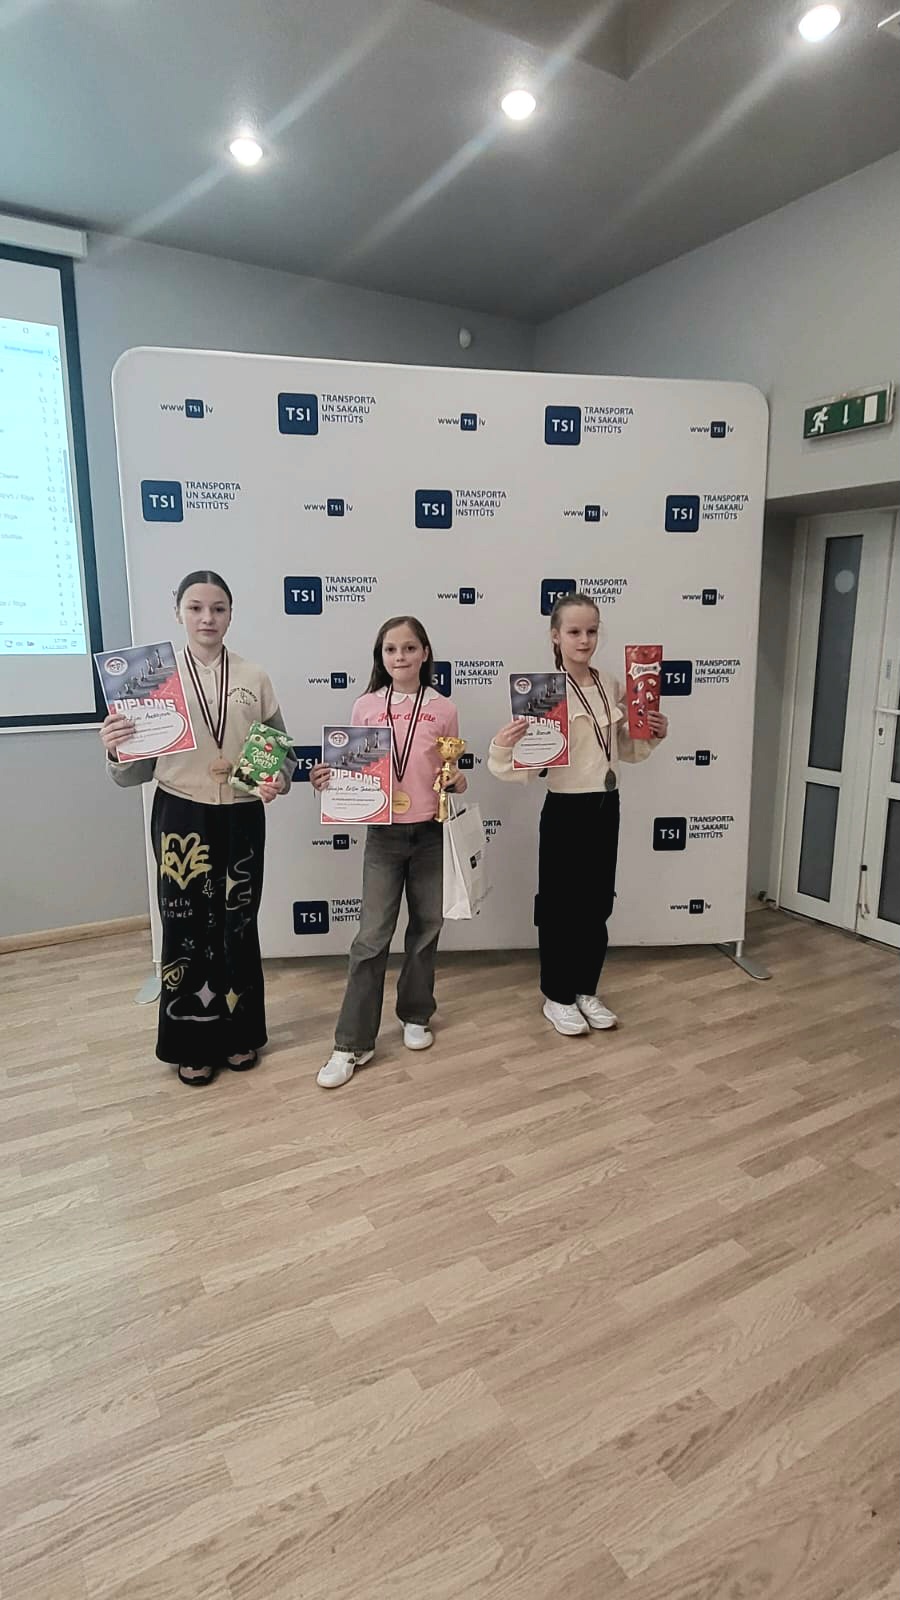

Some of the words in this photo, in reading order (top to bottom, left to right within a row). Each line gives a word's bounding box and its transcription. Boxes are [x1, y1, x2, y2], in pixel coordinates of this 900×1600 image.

[321, 394, 376, 405] TRANSPORTA
[205, 404, 214, 413] lv
[321, 404, 334, 412] UN
[336, 405, 370, 415] SAKARU
[584, 406, 634, 415] TRANSPORTA
[285, 407, 310, 421] TSI
[437, 416, 460, 427] www
[478, 417, 486, 426] lv
[584, 415, 596, 423] UN
[598, 415, 628, 425] SAKARU
[551, 419, 574, 432] TSI
[727, 425, 734, 433] lv
[185, 481, 241, 491] TRANSPORTA
[185, 491, 199, 499] UN
[201, 491, 235, 500] SAKARU
[456, 490, 507, 499] TRANSPORTA
[703, 494, 749, 502] TRANSPORTA
[149, 494, 175, 508] TSI
[455, 499, 468, 507] UN
[469, 499, 501, 509] SAKARU
[346, 503, 353, 511] lv
[422, 503, 445, 516] TSI
[715, 503, 744, 512] SAKARU
[602, 509, 609, 517] lv
[672, 508, 693, 520] TSI
[325, 576, 378, 584] TRANSPORTA
[580, 578, 628, 586] TRANSPORTA
[325, 585, 338, 593] UN
[339, 585, 372, 593] SAKARU
[578, 587, 591, 595] UN
[592, 587, 622, 595] SAKARU
[291, 589, 315, 602] TSI
[476, 591, 484, 599] lv
[454, 660, 504, 668] TRANSPORTA
[695, 659, 741, 667] TRANSPORTA
[468, 669, 499, 677] SAKARU
[348, 676, 356, 684] lv
[665, 673, 686, 684] TSI
[114, 698, 177, 712] DIPLOMS
[711, 753, 718, 761] lv
[330, 768, 381, 789] DIPLOMS
[689, 815, 734, 823] TRANSPORTA
[701, 823, 729, 831] SAKARU
[660, 829, 680, 839] TSI
[300, 912, 322, 923] TSI
